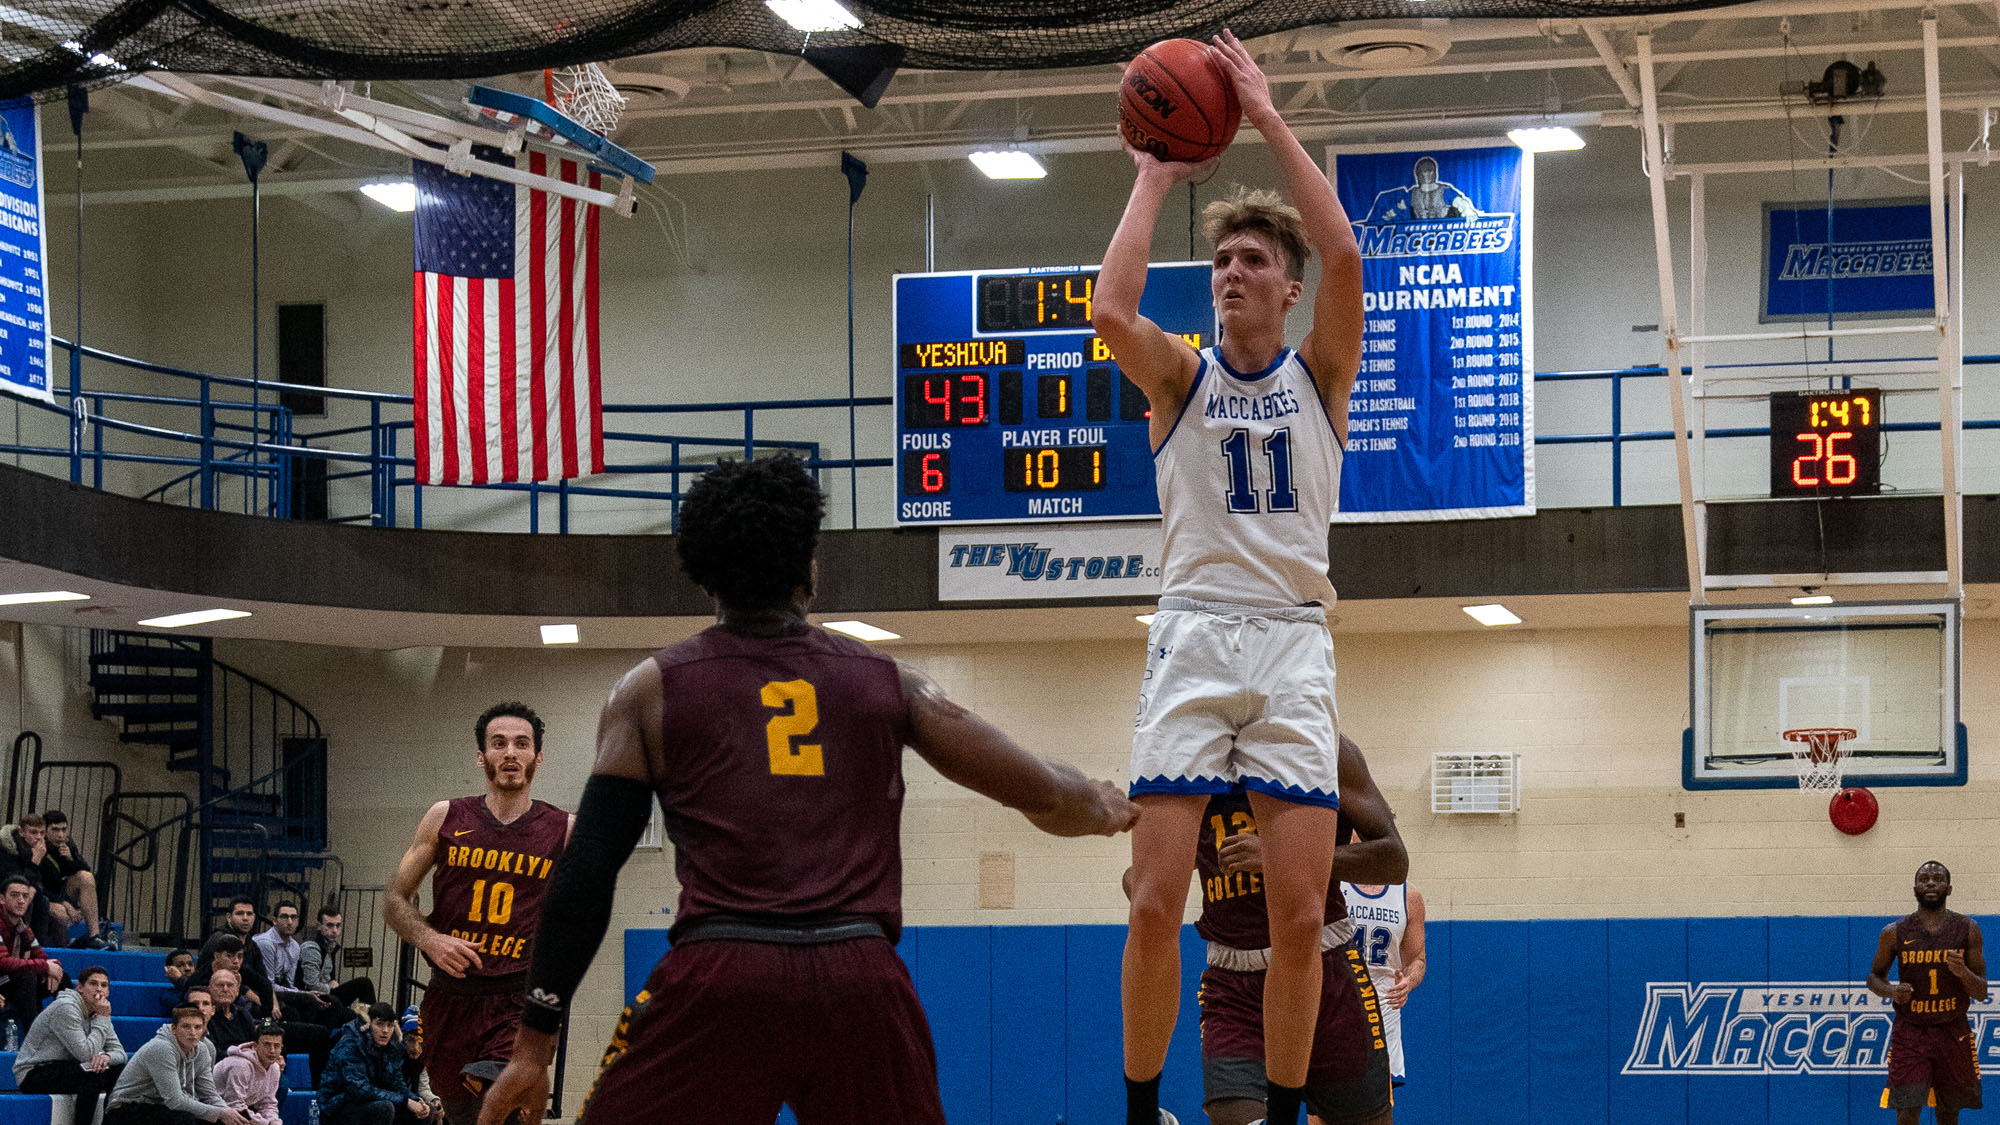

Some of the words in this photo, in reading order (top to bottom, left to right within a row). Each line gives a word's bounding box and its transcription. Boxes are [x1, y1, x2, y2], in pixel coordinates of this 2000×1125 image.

[0, 209, 38, 237] ERICANS
[1404, 223, 1443, 232] YESHIVA
[1446, 220, 1504, 231] UNIVERSITY
[1359, 225, 1509, 256] MACCABEES
[1030, 265, 1079, 273] DAKTRONICS
[1400, 263, 1463, 286] NCAA
[1037, 279, 1092, 324] 1:4
[1363, 285, 1516, 312] OURNAMENT
[1369, 319, 1397, 333] TENNIS
[1465, 314, 1493, 329] ROUND
[1499, 312, 1520, 328] 2014
[916, 341, 1008, 368] YESHIVA
[1369, 339, 1397, 353] TENNIS
[1465, 334, 1493, 348] ROUND
[1499, 332, 1519, 347] 2015
[1027, 352, 1083, 371] PERIOD
[1369, 358, 1396, 373] TENNIS
[1466, 354, 1494, 368] ROUND
[1499, 352, 1520, 367] 2016
[1058, 379, 1067, 413] 1
[1351, 379, 1368, 393] EN'S
[1369, 378, 1397, 392] TENNIS
[1467, 374, 1495, 388] ROUND
[1499, 372, 1519, 387] 2017
[1798, 389, 1850, 397] DAKTRONICS
[923, 375, 985, 424] 43
[1204, 389, 1300, 421] MACCABEES
[1369, 396, 1416, 412] BASKETBALL
[1467, 393, 1495, 408] ROUND
[1499, 392, 1519, 407] 2018
[1811, 397, 1870, 428] 1:47
[1381, 416, 1409, 431] TENNIS
[1468, 413, 1496, 428] ROUND
[902, 433, 952, 450] FOULS
[1003, 429, 1061, 447] PLAYER
[1068, 426, 1107, 445] FOUL
[1369, 437, 1397, 452] TENNIS
[1469, 433, 1497, 448] ROUND
[922, 453, 944, 493] 6
[1025, 449, 1060, 489] 10
[1092, 450, 1101, 485] 1
[1220, 426, 1299, 515] 11
[1793, 431, 1857, 488] 26
[902, 502, 952, 518] SCORE
[1028, 497, 1083, 515] MATCH
[760, 678, 825, 776] 2
[448, 846, 553, 880] BROOKLYN
[1206, 870, 1262, 904] COLLE
[468, 879, 515, 925] 10
[1346, 905, 1400, 924] ACCABEES
[1352, 924, 1393, 967] 42
[1901, 949, 1965, 965] BROOKL
[1928, 968, 1939, 995] 1
[1345, 949, 1386, 1050] BROOKLYN
[1761, 992, 1870, 1007] YESHIVA
[1910, 997, 1957, 1014] COLLEGE
